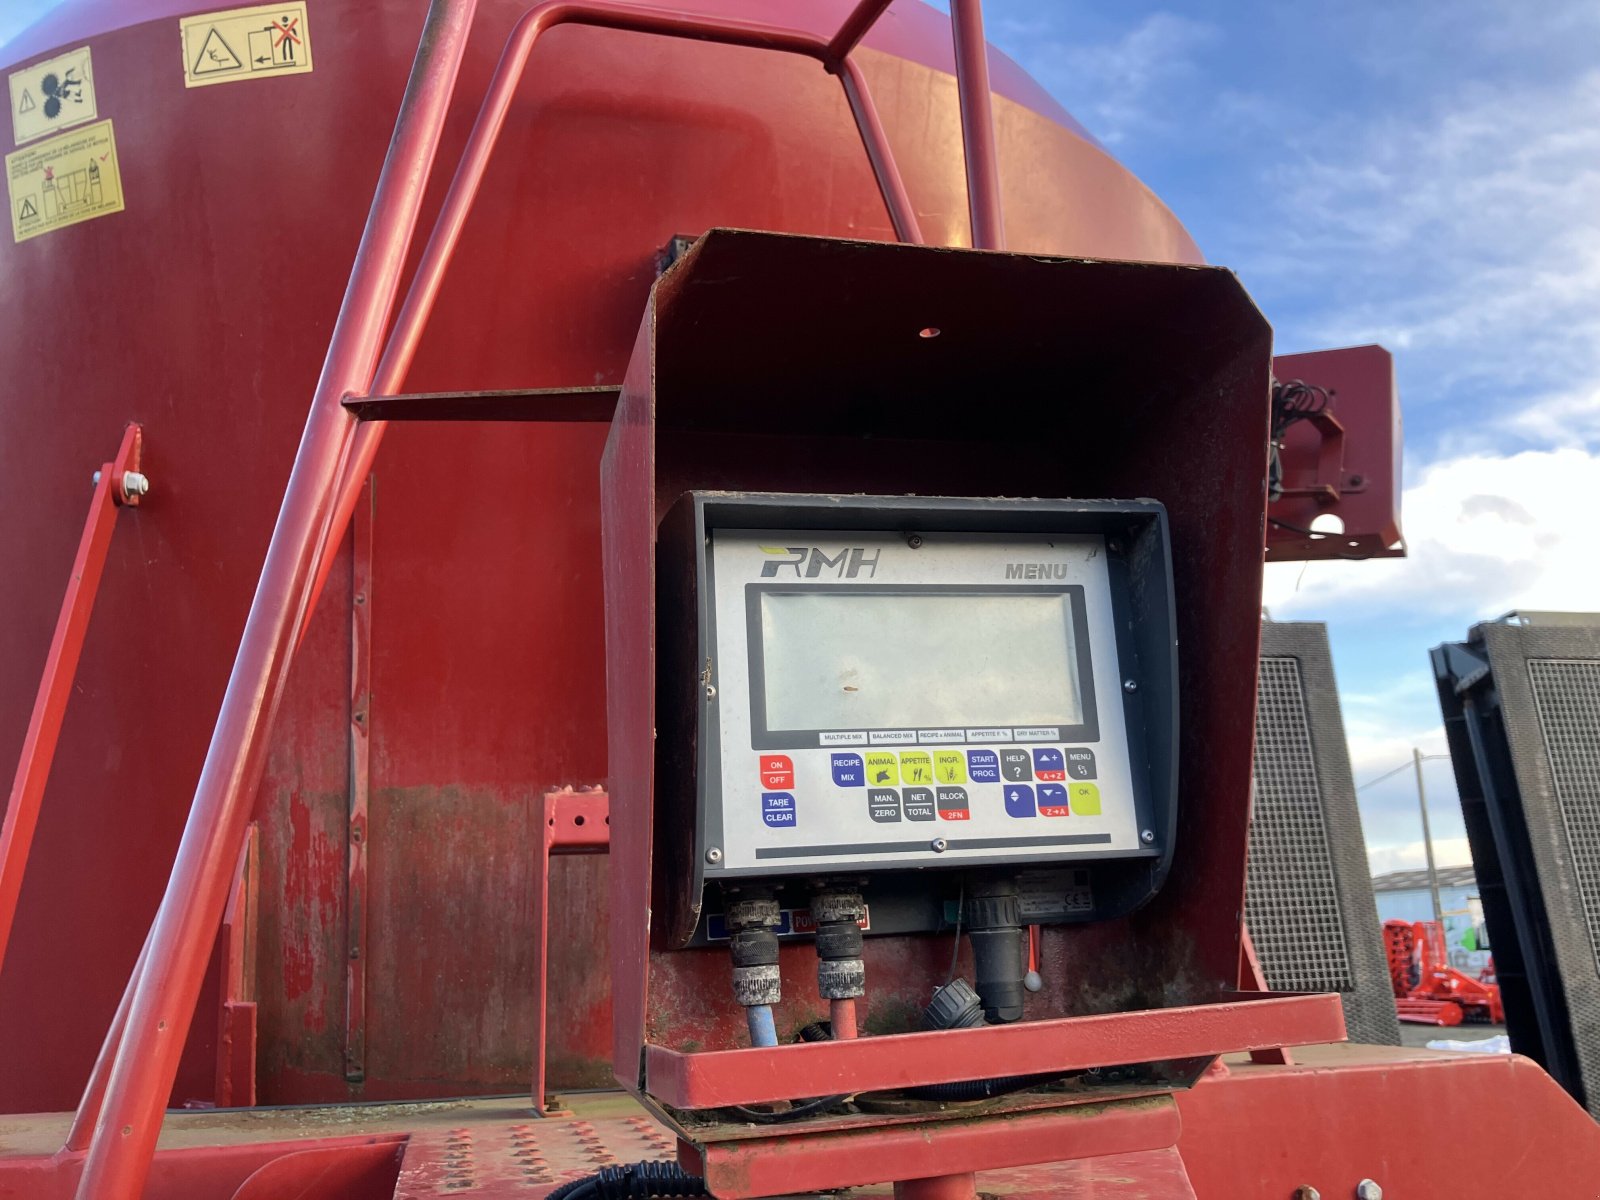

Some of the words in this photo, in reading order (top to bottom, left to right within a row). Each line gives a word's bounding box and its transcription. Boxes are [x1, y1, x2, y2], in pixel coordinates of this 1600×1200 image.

[758, 546, 881, 578] RMH
[1005, 563, 1068, 579] MENU
[833, 759, 860, 767] RECIPE
[971, 755, 994, 763] START
[770, 761, 783, 769] ON
[840, 773, 855, 781] MIX
[972, 769, 996, 777] PROG.
[769, 776, 785, 784] OFF
[874, 794, 895, 802] MAN.
[911, 793, 927, 801] NET
[939, 792, 965, 800] BLOCK
[768, 798, 789, 807] TARE
[874, 809, 896, 817] ZERO
[766, 813, 793, 822] CLEAR
